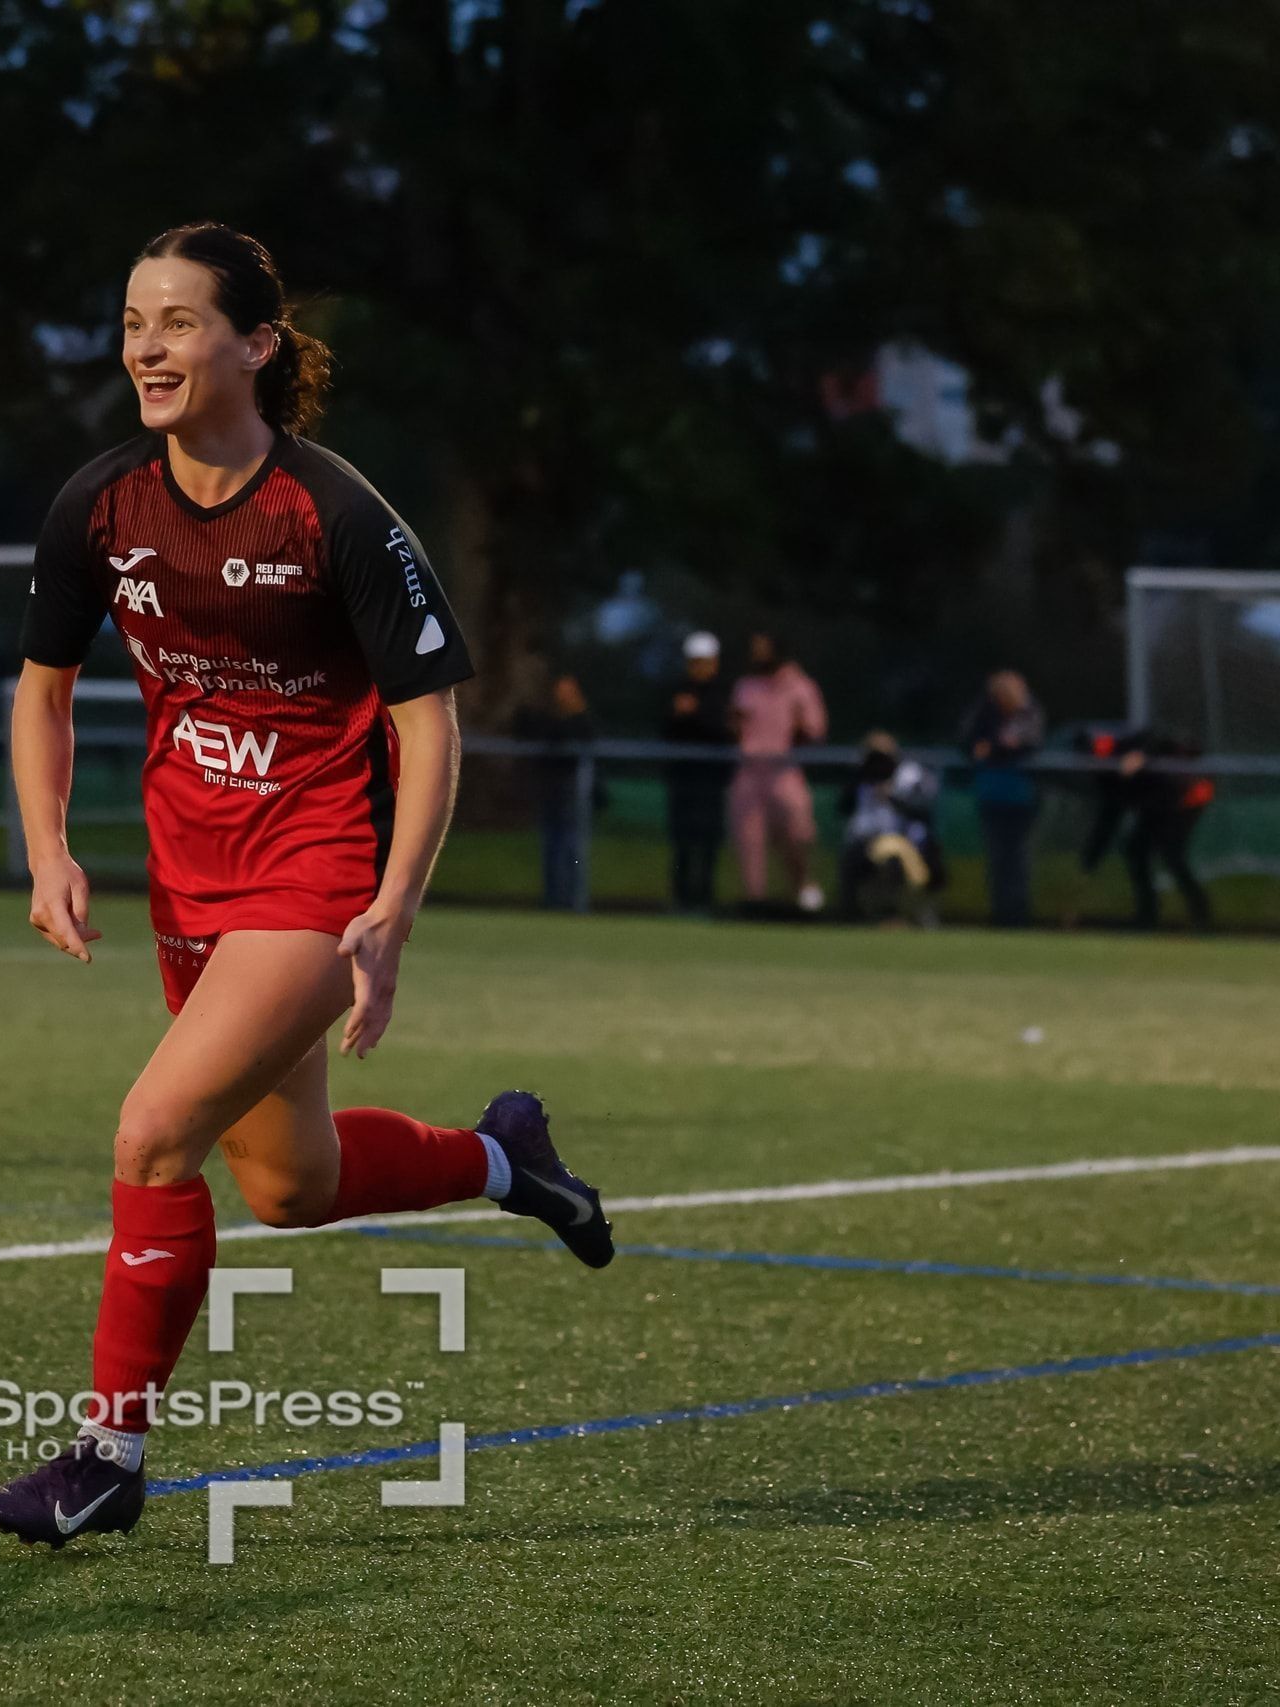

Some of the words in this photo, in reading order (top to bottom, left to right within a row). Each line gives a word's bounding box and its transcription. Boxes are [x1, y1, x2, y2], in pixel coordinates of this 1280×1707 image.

[255, 563, 273, 575] RED
[275, 564, 303, 576] BOOTS
[255, 575, 286, 585] AARAU
[113, 576, 165, 618] AXA
[158, 647, 279, 675] Aargauische
[173, 711, 279, 777] AEW
[204, 769, 226, 787] Ihre
